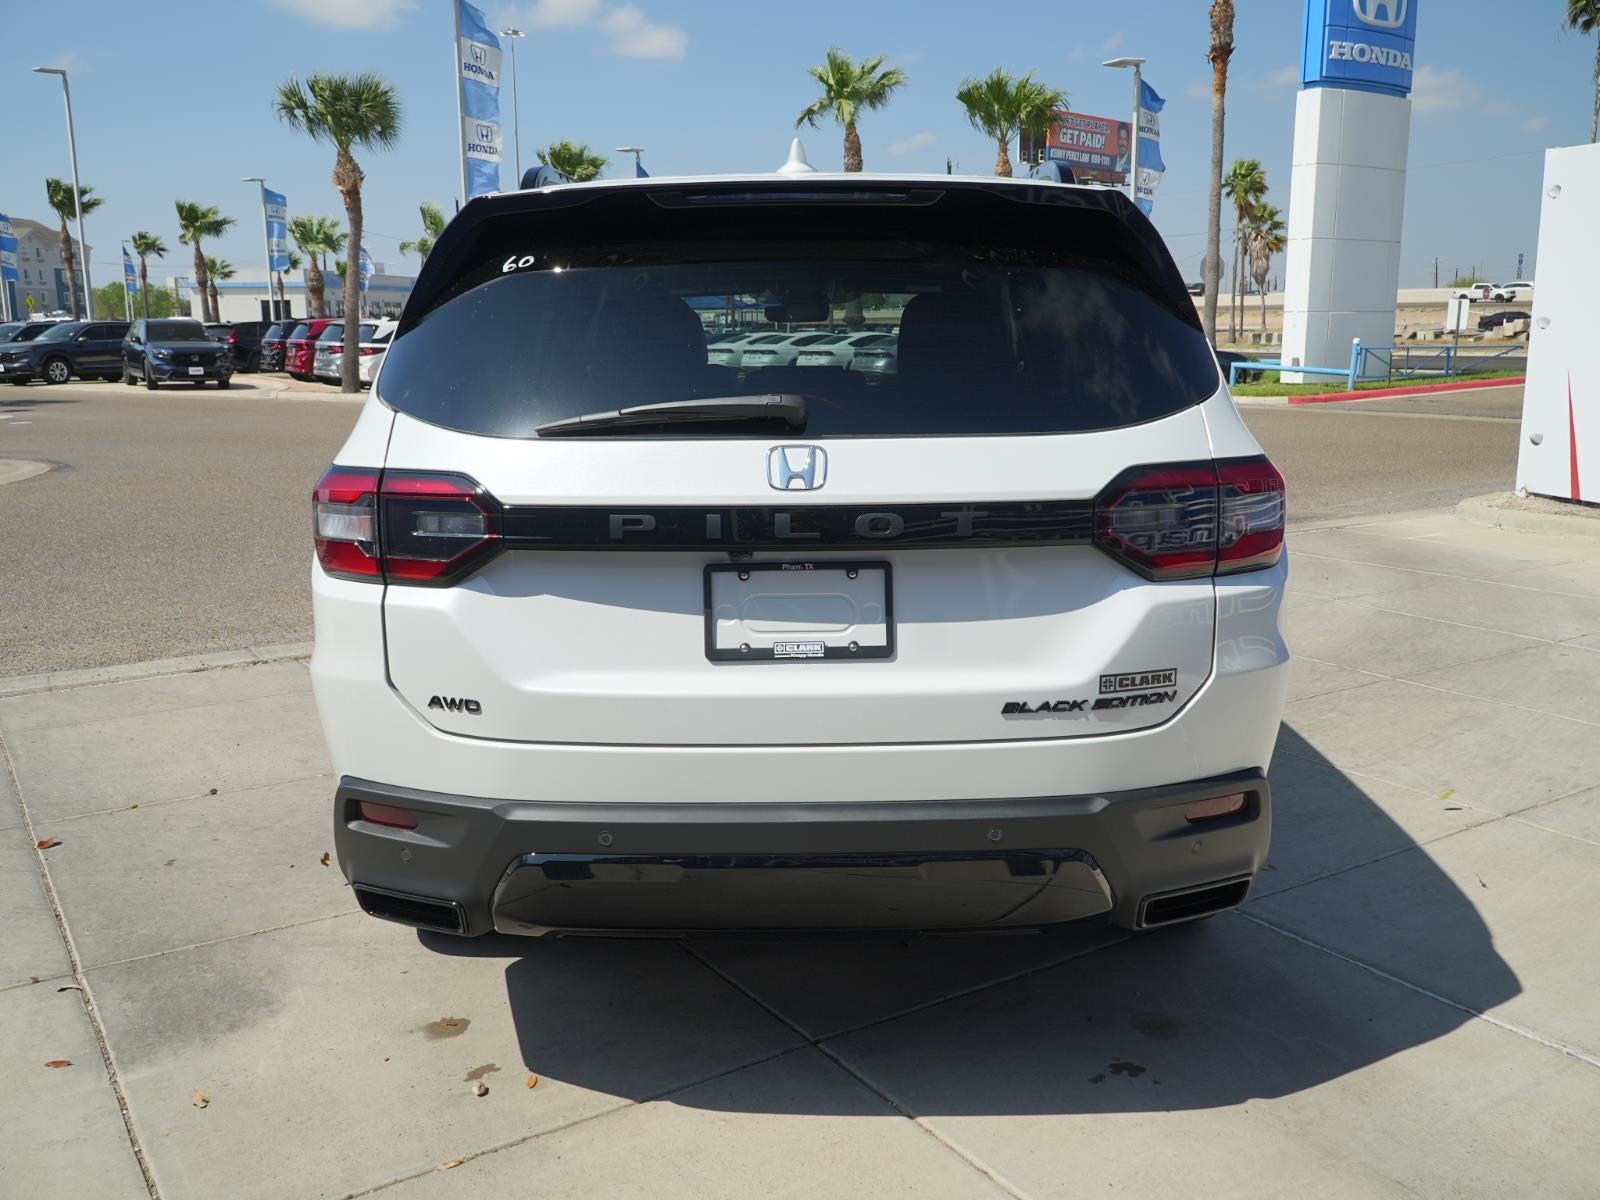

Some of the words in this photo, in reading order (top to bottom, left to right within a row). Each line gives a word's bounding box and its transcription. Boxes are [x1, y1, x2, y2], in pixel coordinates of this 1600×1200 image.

[1329, 41, 1412, 70] HONDA
[463, 62, 494, 80] HONDA
[1060, 127, 1079, 145] GET
[1080, 131, 1105, 149] PAID!
[467, 143, 499, 156] HONDA
[502, 255, 534, 272] 60
[608, 511, 988, 540] PILOT
[1118, 672, 1174, 690] CLARK
[427, 695, 481, 713] AWD
[1001, 699, 1089, 714] BLACK
[1093, 691, 1178, 710] EDITION
